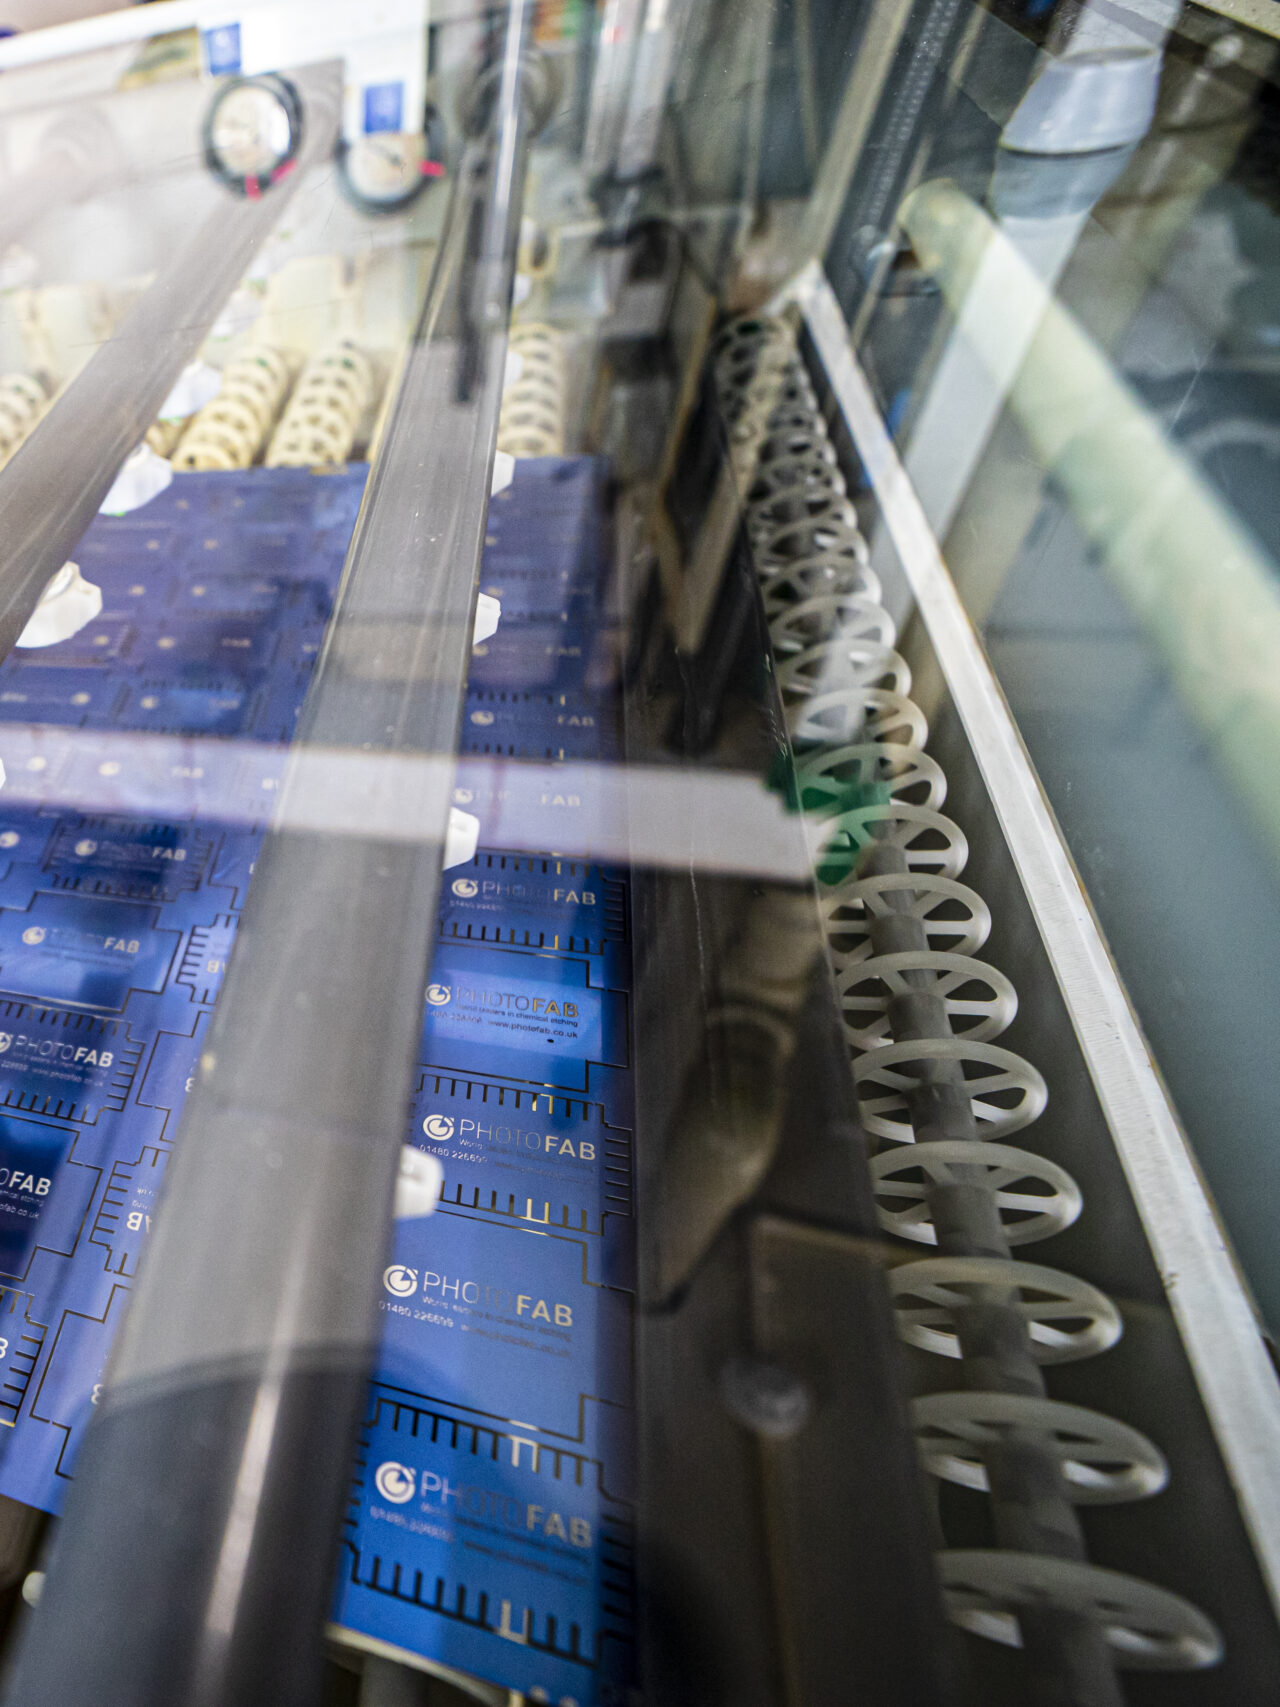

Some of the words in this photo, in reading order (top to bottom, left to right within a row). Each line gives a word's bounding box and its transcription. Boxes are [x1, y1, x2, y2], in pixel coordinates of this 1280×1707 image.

[483, 881, 596, 905] PHOFAB
[488, 1021, 577, 1038] www.photofab.co.uk
[516, 1013, 548, 1022] chemical
[551, 1019, 578, 1028] etching
[16, 1035, 113, 1067] PHOTOFAB
[460, 1119, 595, 1160] PHOTOFAB
[424, 1271, 572, 1326] PHOTOFAB
